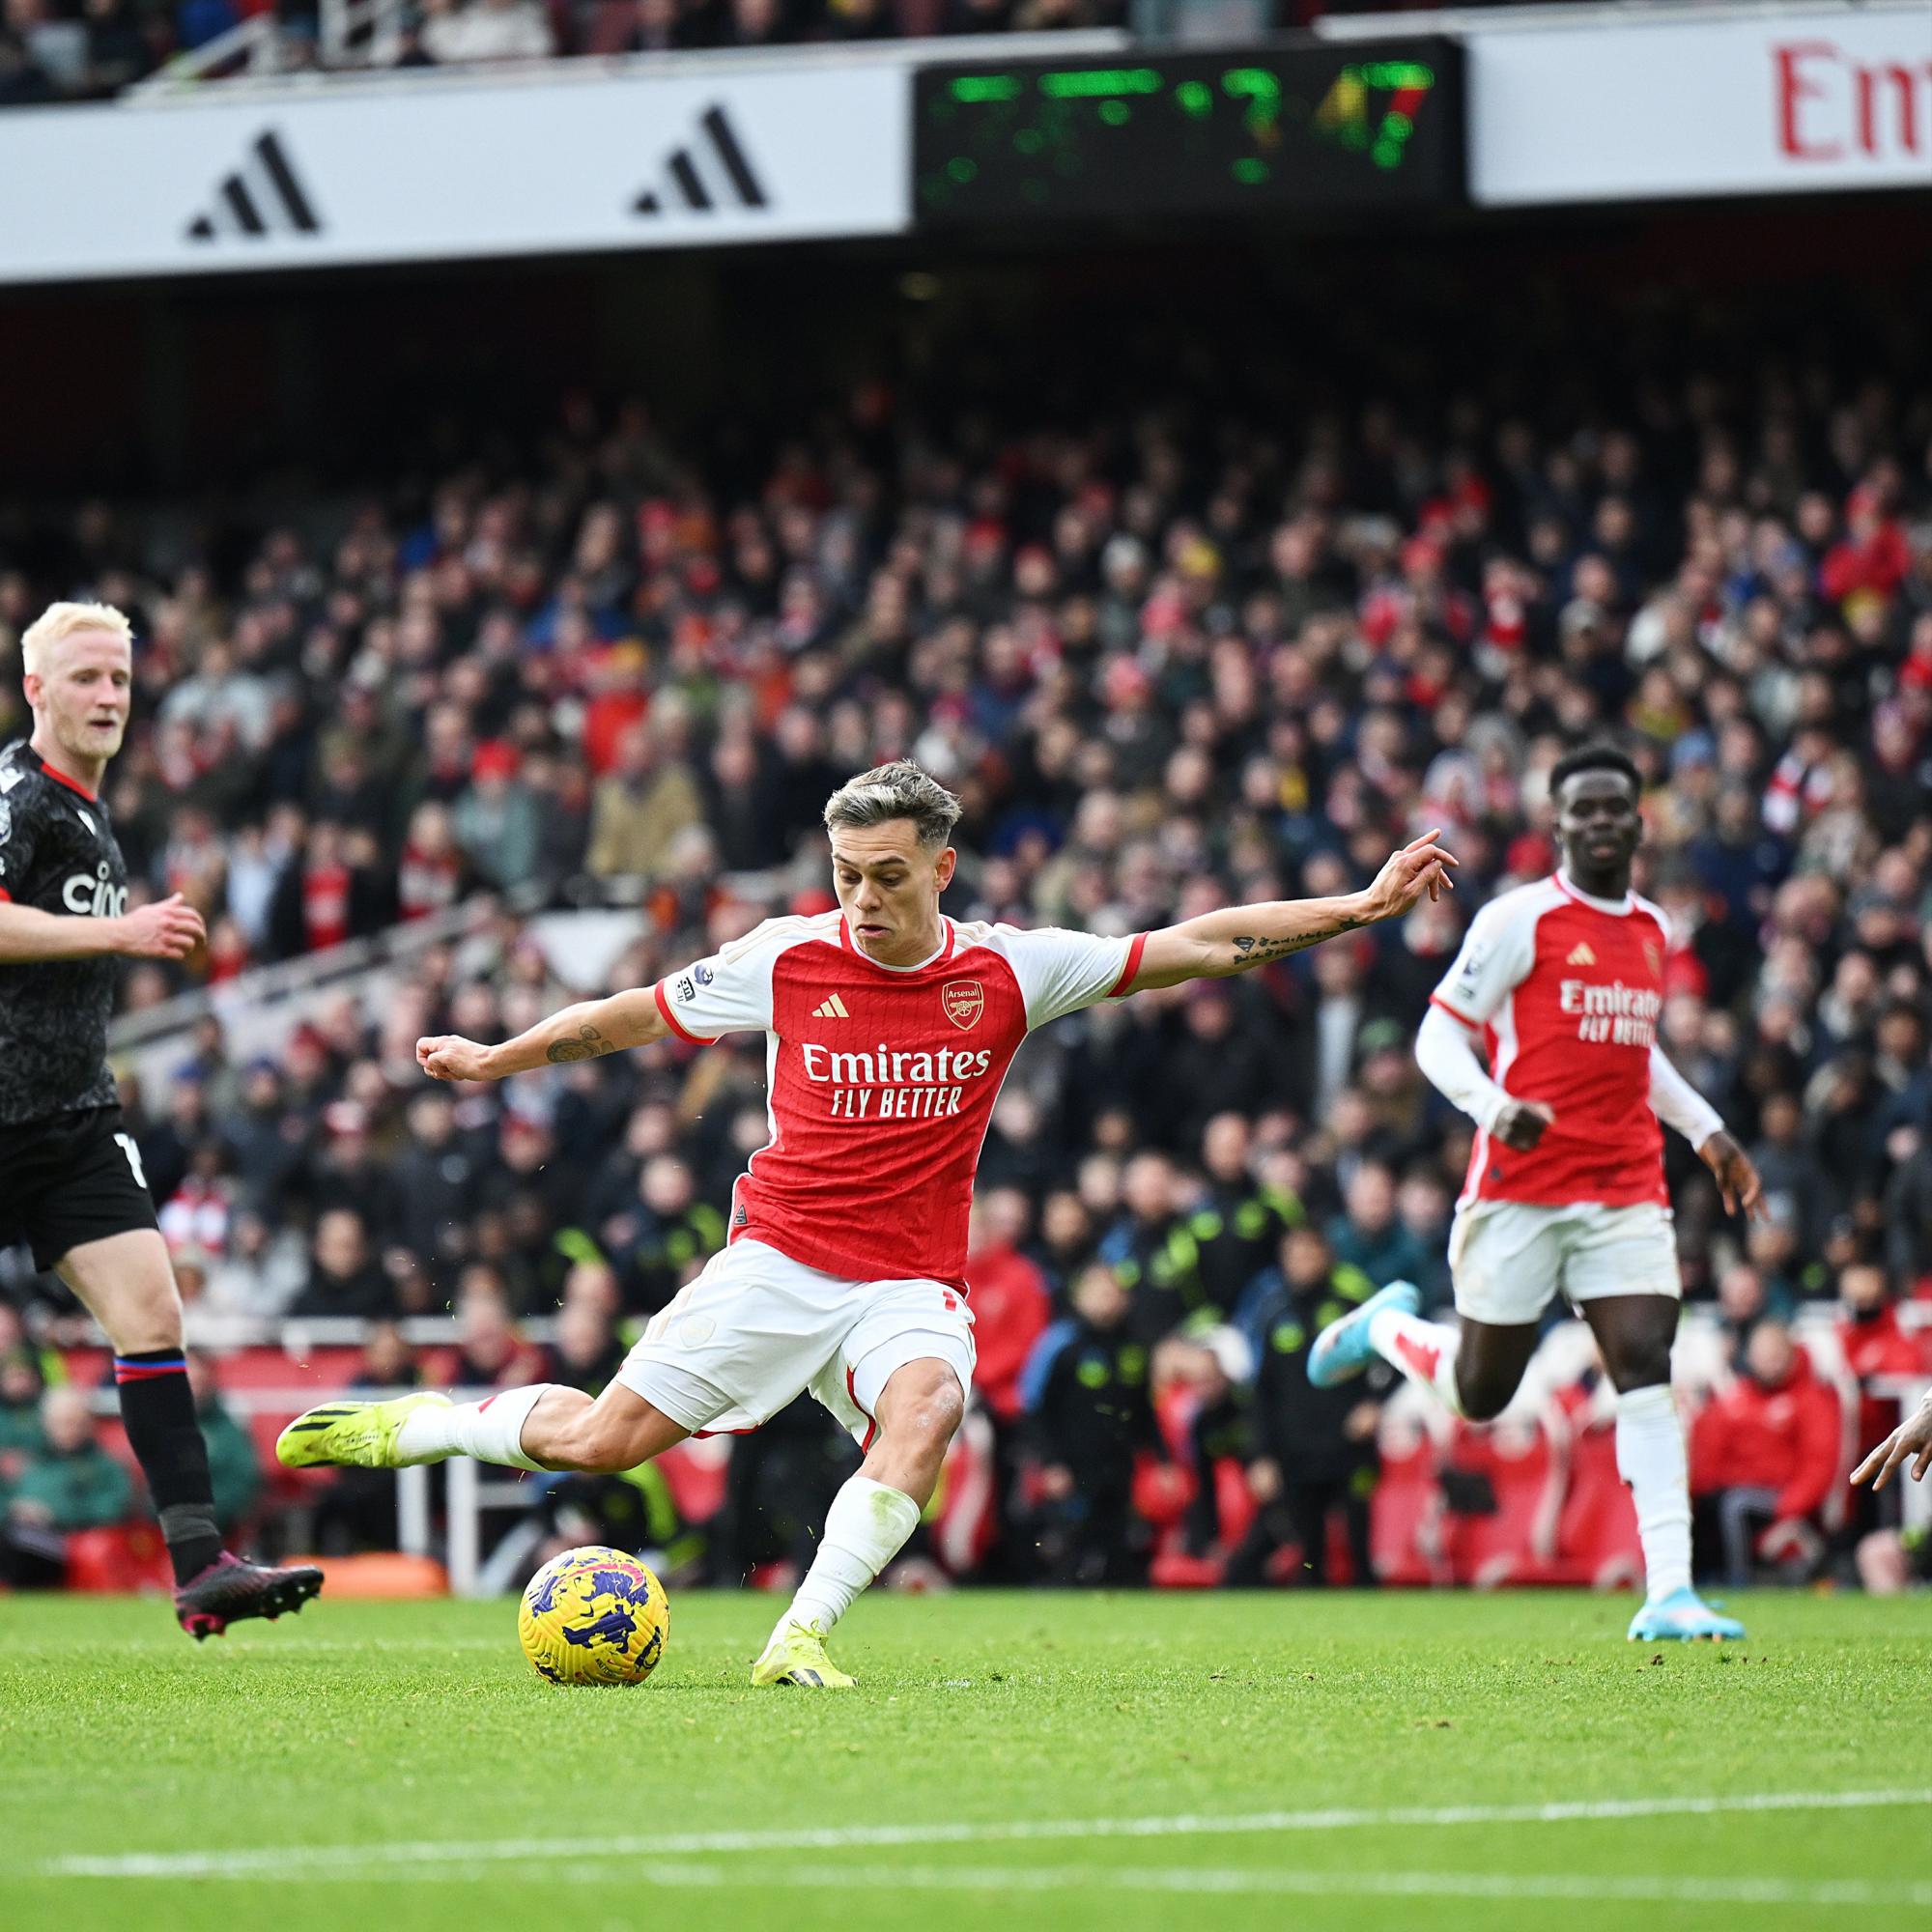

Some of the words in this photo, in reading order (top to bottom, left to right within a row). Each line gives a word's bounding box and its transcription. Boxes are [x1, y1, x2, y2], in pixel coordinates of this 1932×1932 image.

[948, 988, 978, 999] Arsenal
[801, 1042, 991, 1084] Emirates
[830, 1089, 872, 1119] FLY
[878, 1086, 963, 1119] BETTER
